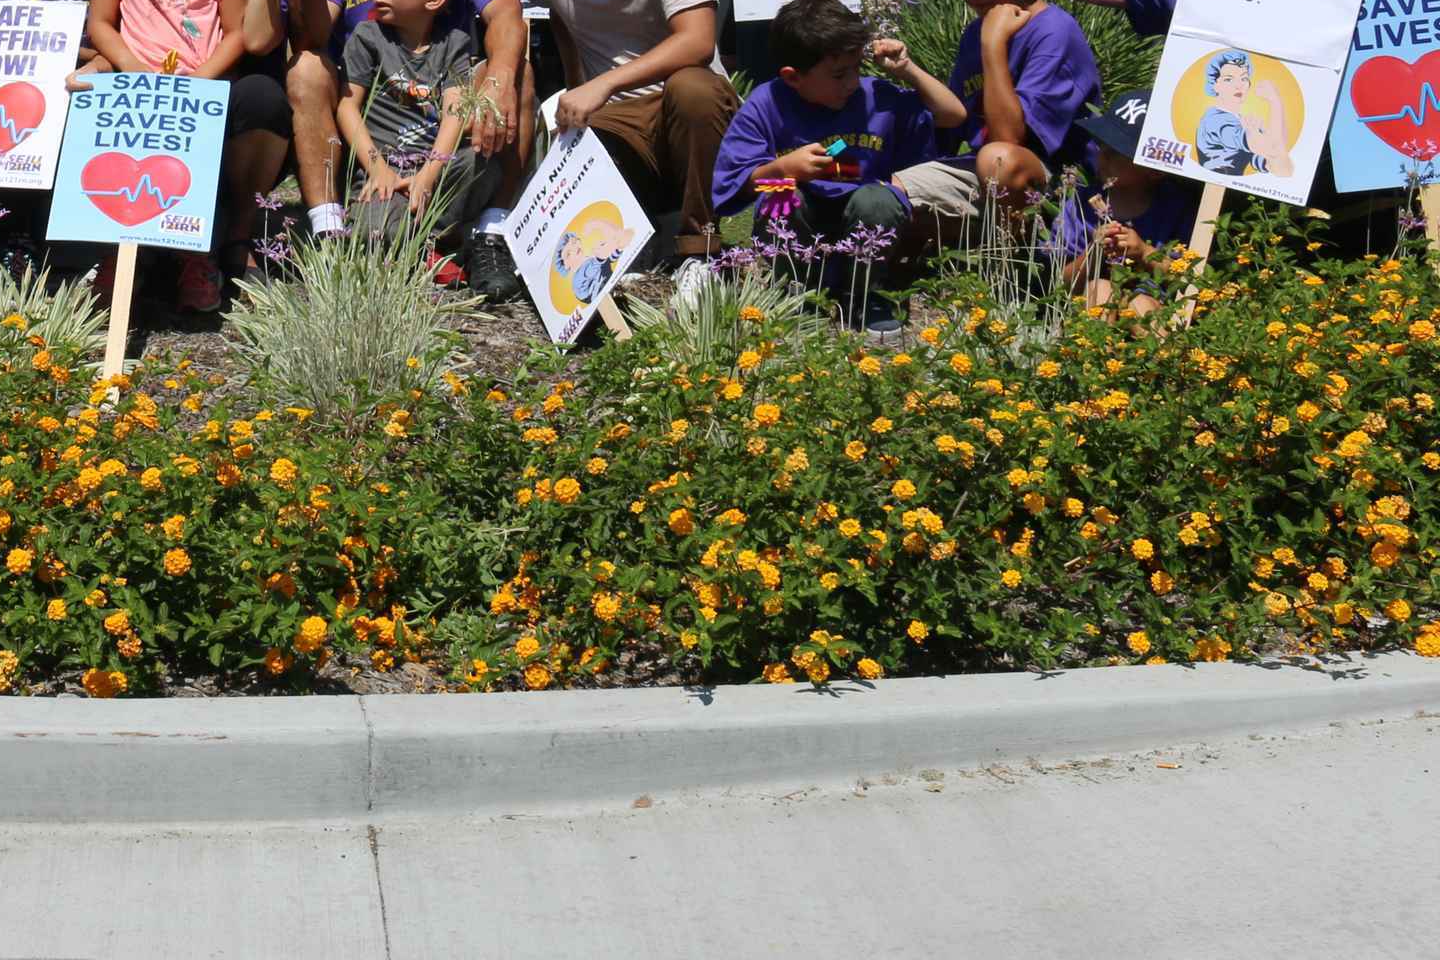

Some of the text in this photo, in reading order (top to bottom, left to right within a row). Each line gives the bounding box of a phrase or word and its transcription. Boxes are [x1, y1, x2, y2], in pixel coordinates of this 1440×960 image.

[112, 74, 191, 94] SAFE
[74, 93, 224, 117] STAFFING
[95, 112, 197, 133] SAVES
[94, 131, 191, 153] LIVES!
[1145, 136, 1188, 154] SEIU
[513, 129, 585, 241] Dignity Nurses
[539, 177, 569, 216] Love
[526, 156, 595, 256] Safe Patients
